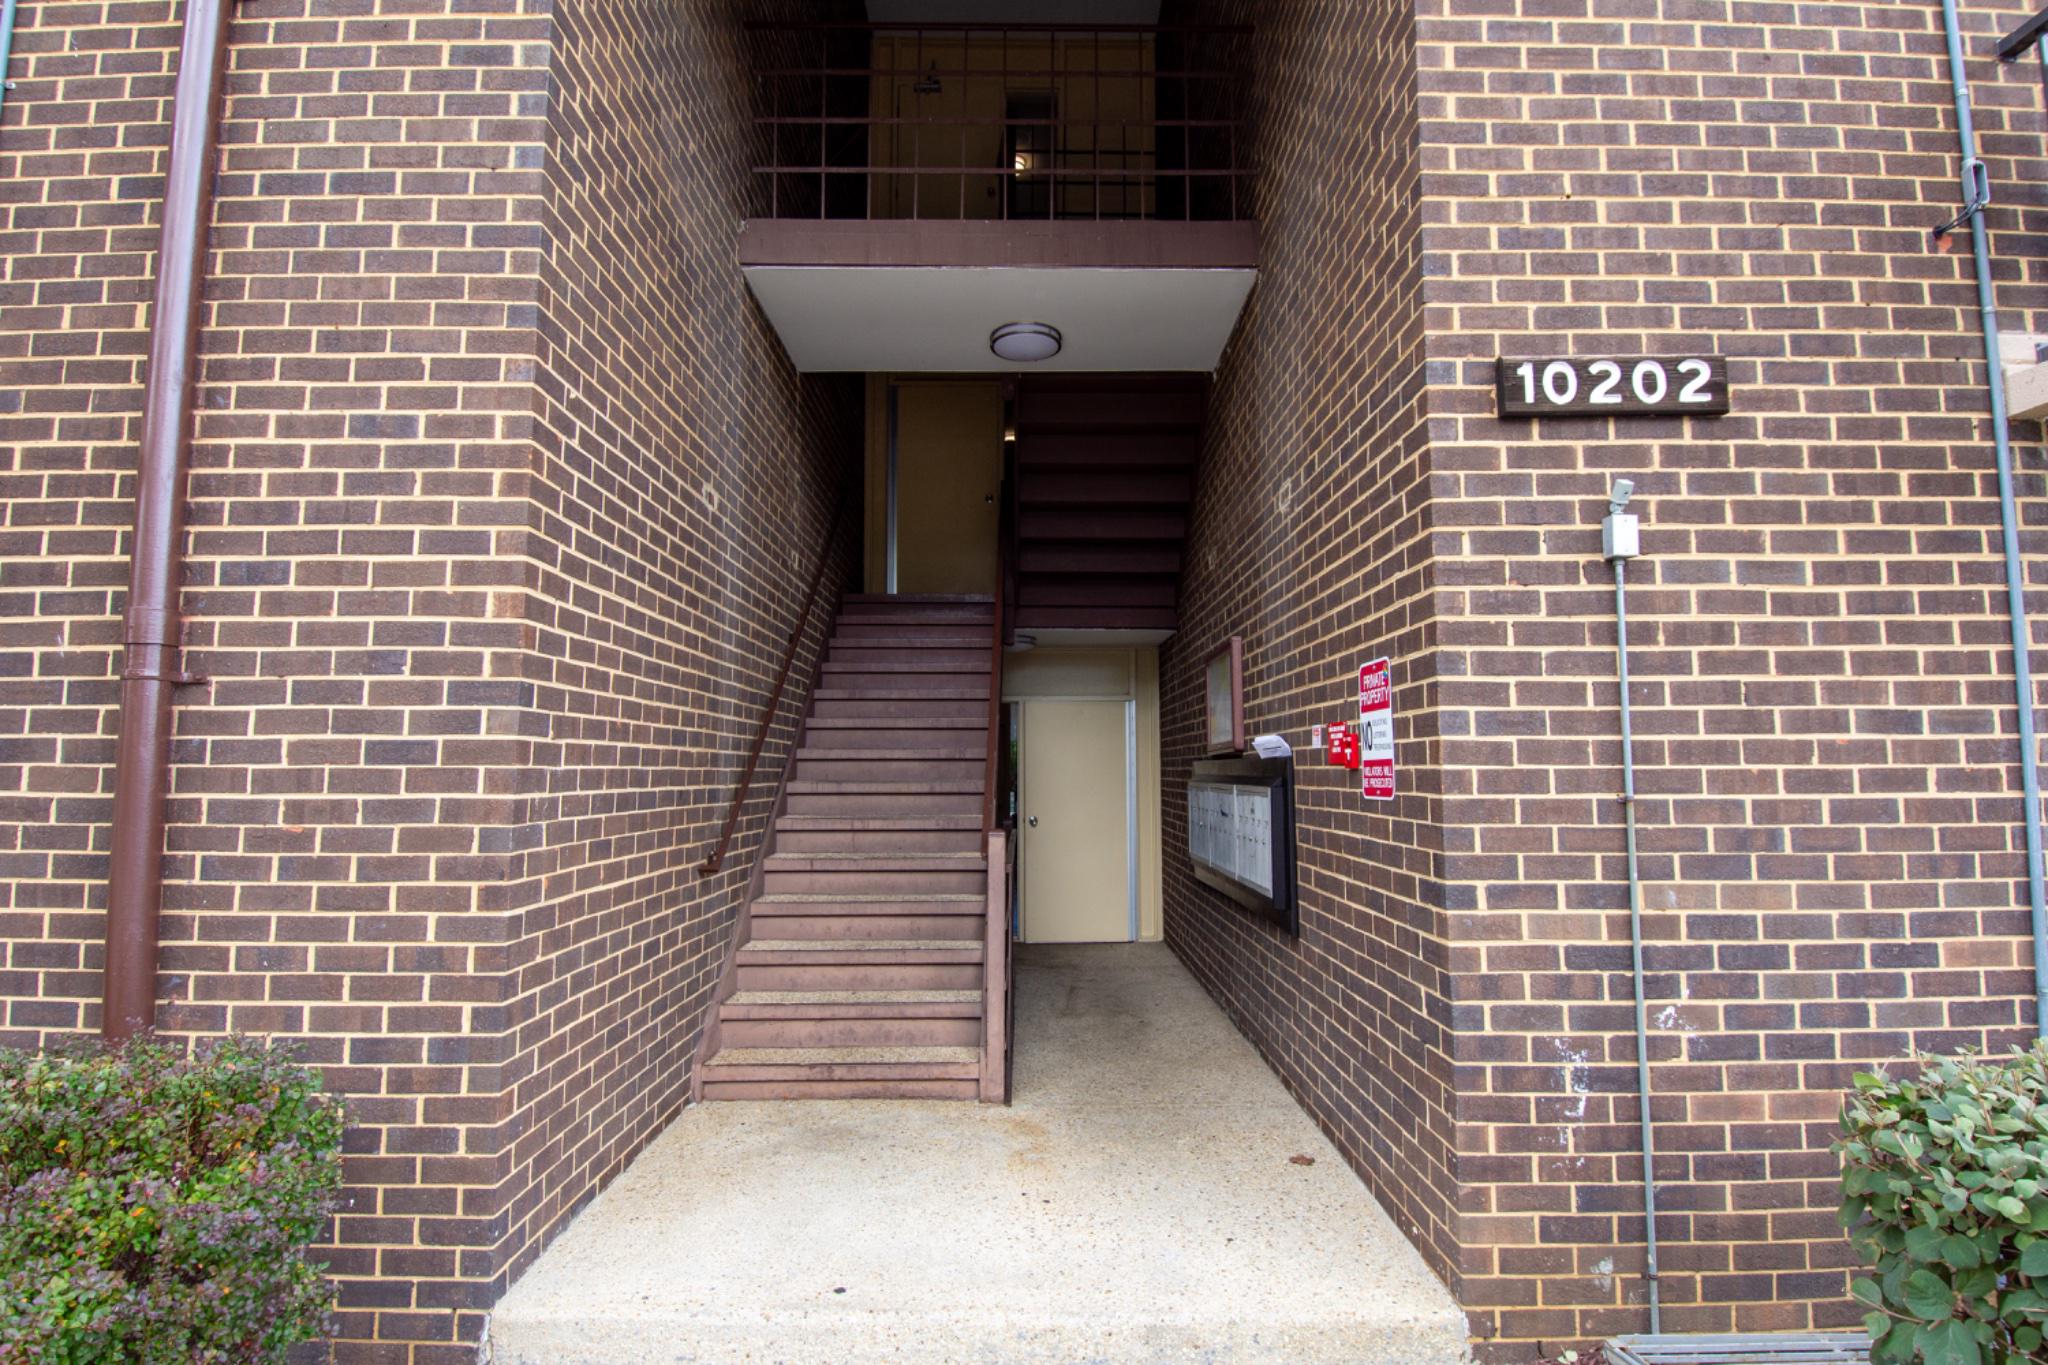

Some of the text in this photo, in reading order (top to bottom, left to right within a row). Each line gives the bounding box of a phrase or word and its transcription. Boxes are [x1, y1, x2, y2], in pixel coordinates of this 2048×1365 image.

[1517, 359, 1712, 404] 10202
[1363, 672, 1385, 687] PRIVATE
[1360, 686, 1389, 705] PROPERTY
[1361, 721, 1372, 751] NO
